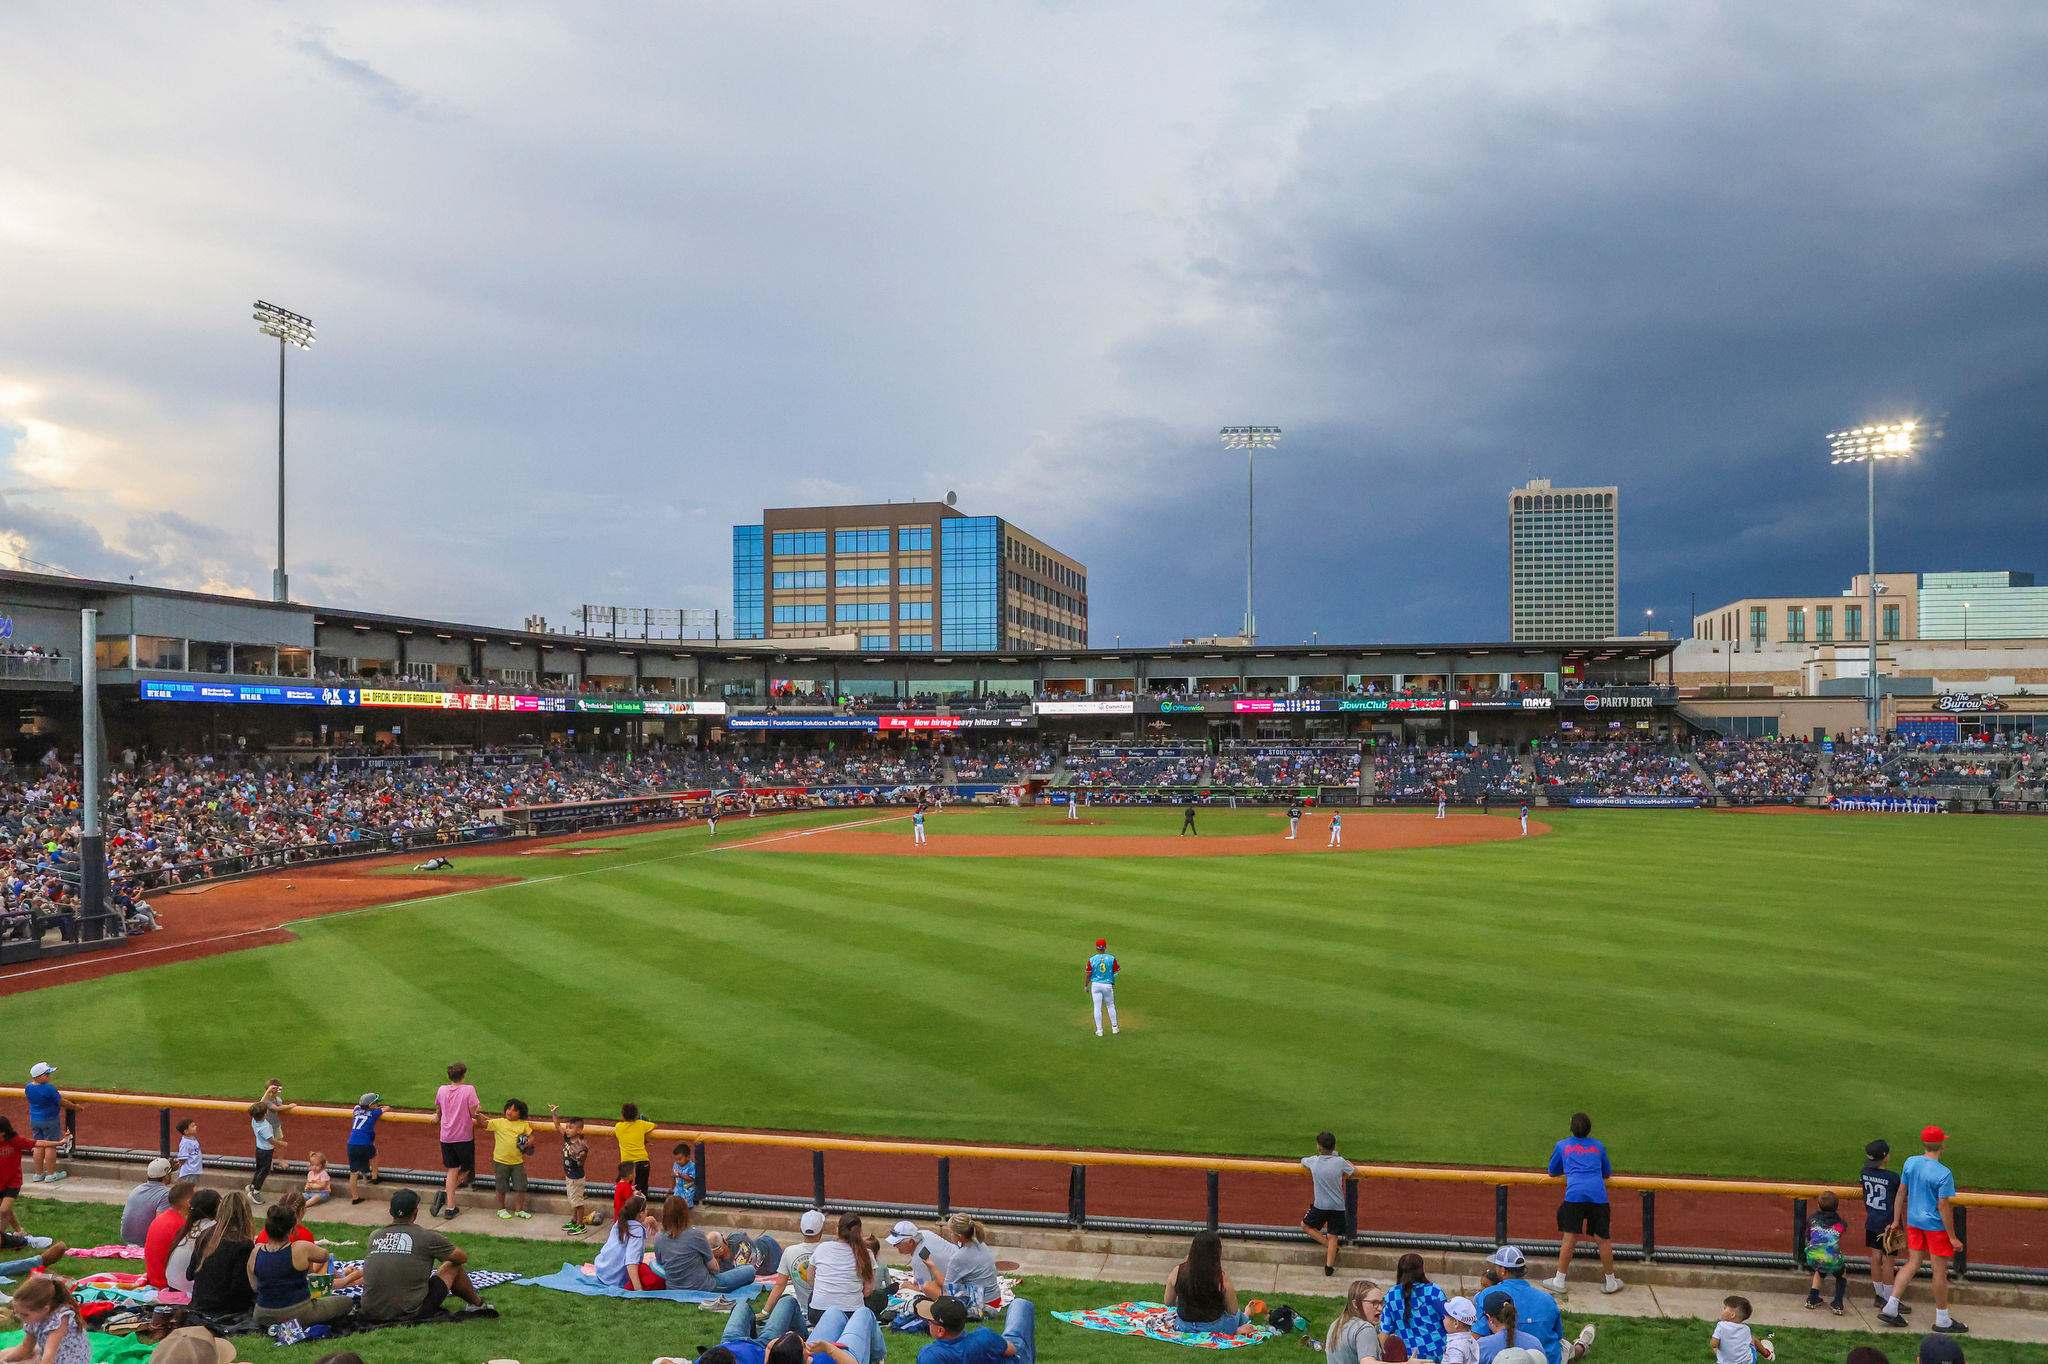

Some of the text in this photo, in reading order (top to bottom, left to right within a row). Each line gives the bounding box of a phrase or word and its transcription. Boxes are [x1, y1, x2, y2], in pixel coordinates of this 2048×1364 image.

[348, 690, 355, 703] 3
[1955, 692, 1969, 701] The
[1173, 703, 1205, 711] Officewise
[1523, 698, 1552, 707] MAYS
[1601, 697, 1628, 707] PARTY
[1630, 697, 1653, 707] DECK
[1940, 697, 1982, 709] Burrow
[931, 719, 951, 727] hiring
[952, 719, 973, 727] heavy
[1099, 963, 1106, 973] 3
[352, 1115, 368, 1129] 17
[1864, 1181, 1886, 1210] 22
